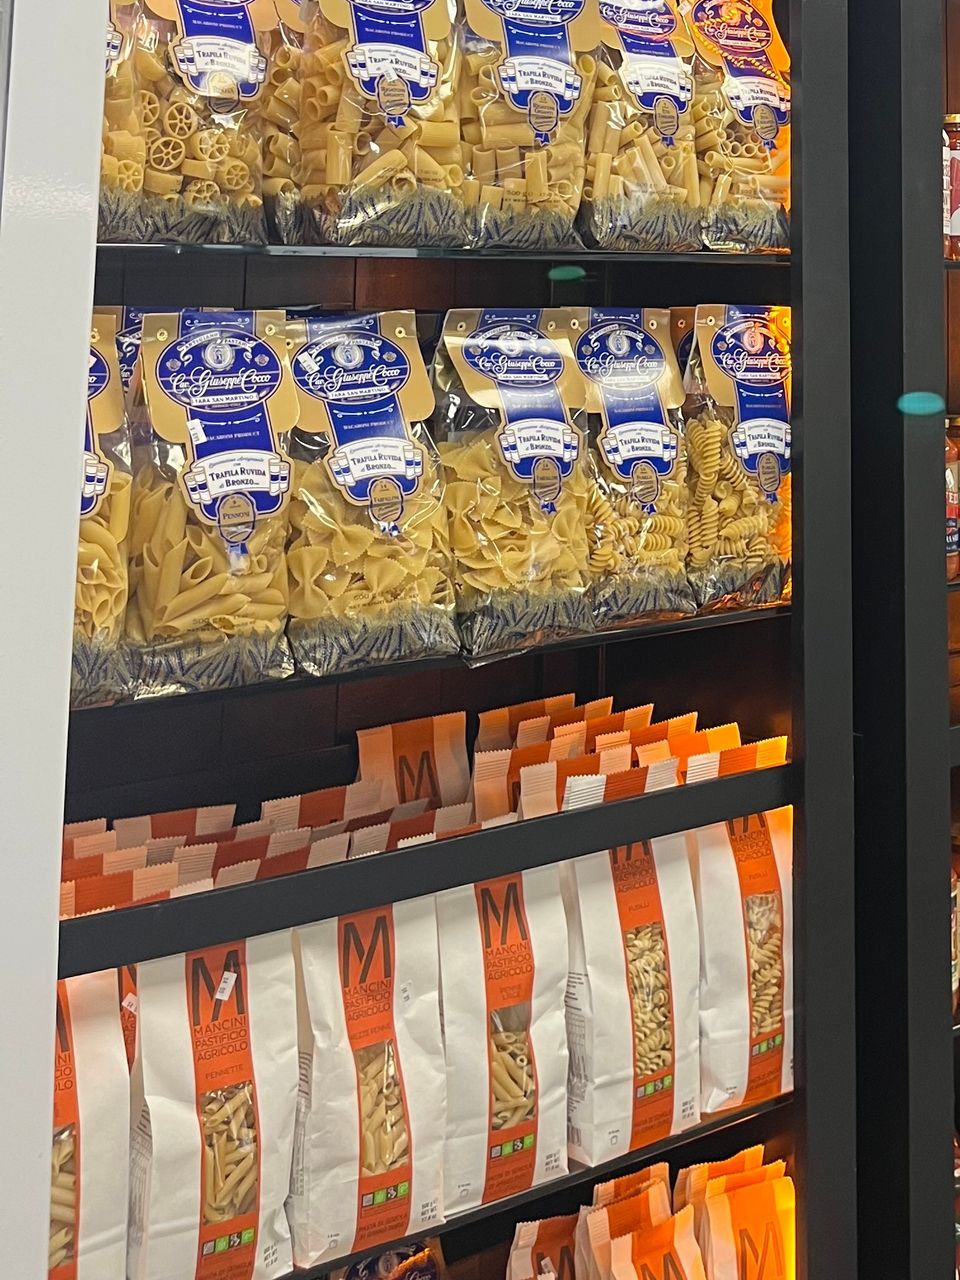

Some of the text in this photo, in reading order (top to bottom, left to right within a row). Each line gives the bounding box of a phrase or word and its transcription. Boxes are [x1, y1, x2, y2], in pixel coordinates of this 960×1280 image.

[187, 367, 242, 398] Giuseppe
[238, 366, 272, 394] Cocco
[323, 366, 374, 394] Giuseppe
[369, 363, 401, 388] Cocco
[225, 394, 255, 403] MARTINO
[378, 452, 403, 463] RUVIDA
[208, 466, 267, 483] TRAFILA RUVIDA
[480, 882, 529, 949] M
[343, 915, 392, 989] M
[484, 942, 529, 959] MANCINI
[486, 951, 532, 972] PASTIFICIO
[488, 963, 534, 982] AGRICOLO
[343, 980, 392, 999] MANCINI
[345, 991, 391, 1011] PASTIFICIO
[347, 1002, 391, 1023] AGRICOLO
[193, 1015, 247, 1038] MANCINI
[195, 1028, 248, 1051] PASTIFICIO
[197, 1040, 249, 1063] AGRICOLO
[205, 1063, 244, 1081] PENNETTE
